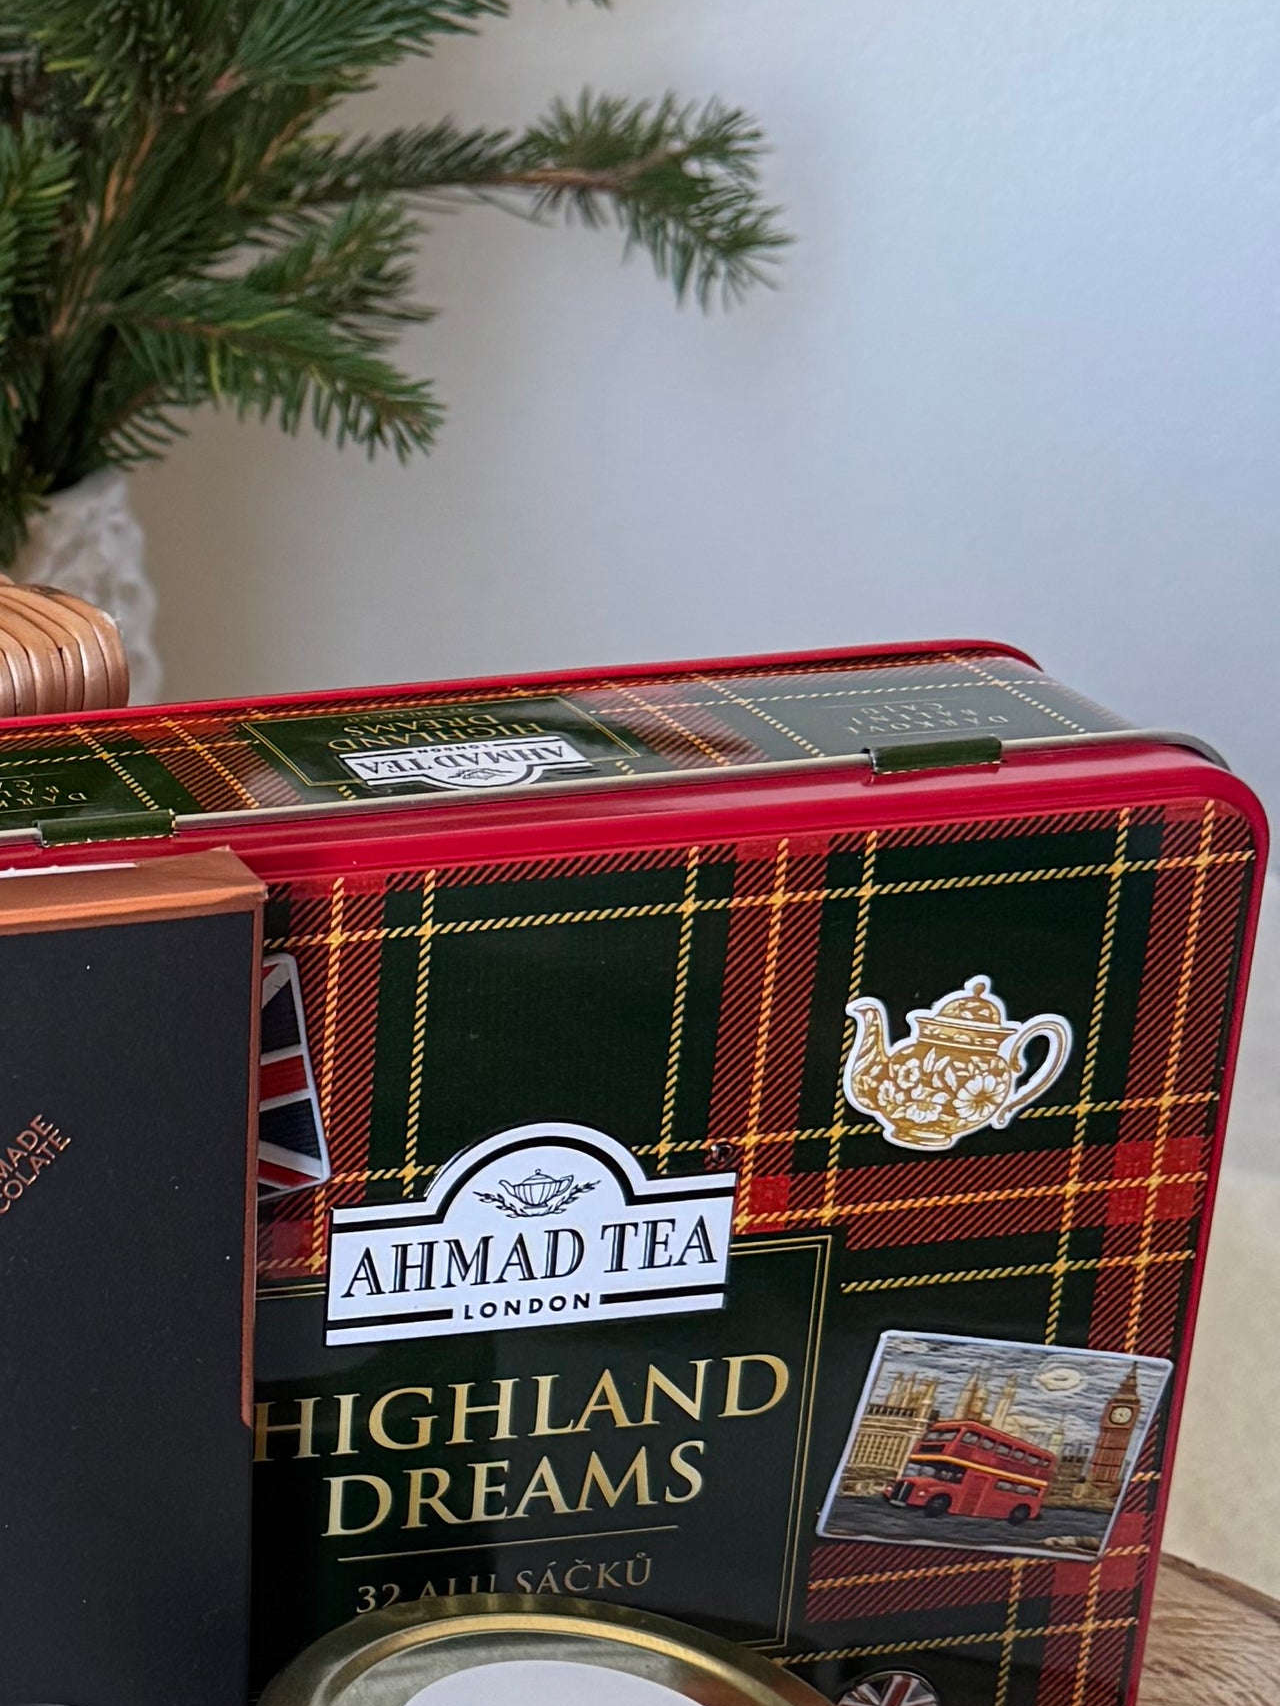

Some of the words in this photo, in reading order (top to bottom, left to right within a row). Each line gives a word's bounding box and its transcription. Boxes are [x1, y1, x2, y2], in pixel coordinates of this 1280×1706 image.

[327, 722, 547, 752] HIGHLAND
[344, 713, 500, 737] DREAMS
[355, 757, 433, 775] TEA
[434, 745, 564, 768] AHMAD
[341, 1227, 586, 1298] AHMAD
[600, 1214, 719, 1274] TEA
[462, 1292, 592, 1321] LONDON
[252, 1353, 791, 1463] HIGHLAND
[320, 1439, 706, 1538] DREAMS
[515, 1551, 653, 1595] SÁČKŮ
